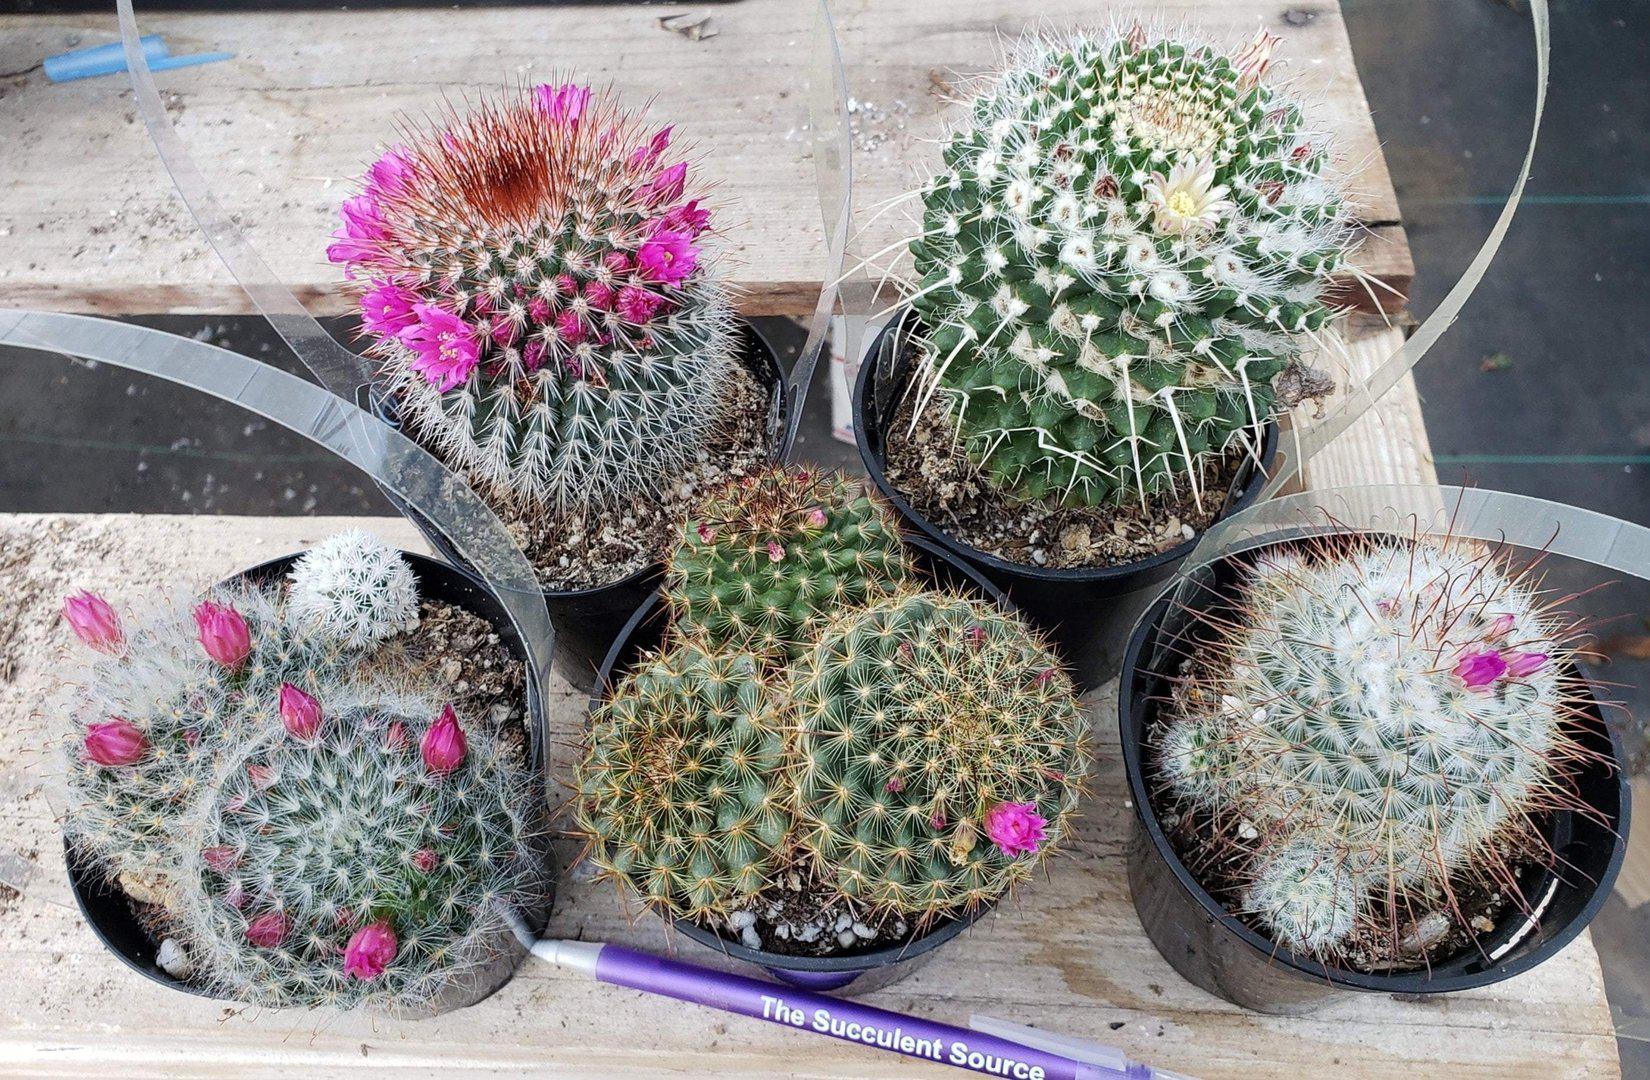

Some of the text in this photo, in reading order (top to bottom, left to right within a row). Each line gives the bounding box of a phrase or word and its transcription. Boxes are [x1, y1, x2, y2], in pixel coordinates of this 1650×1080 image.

[760, 995, 1045, 1080] The Succulent Source
